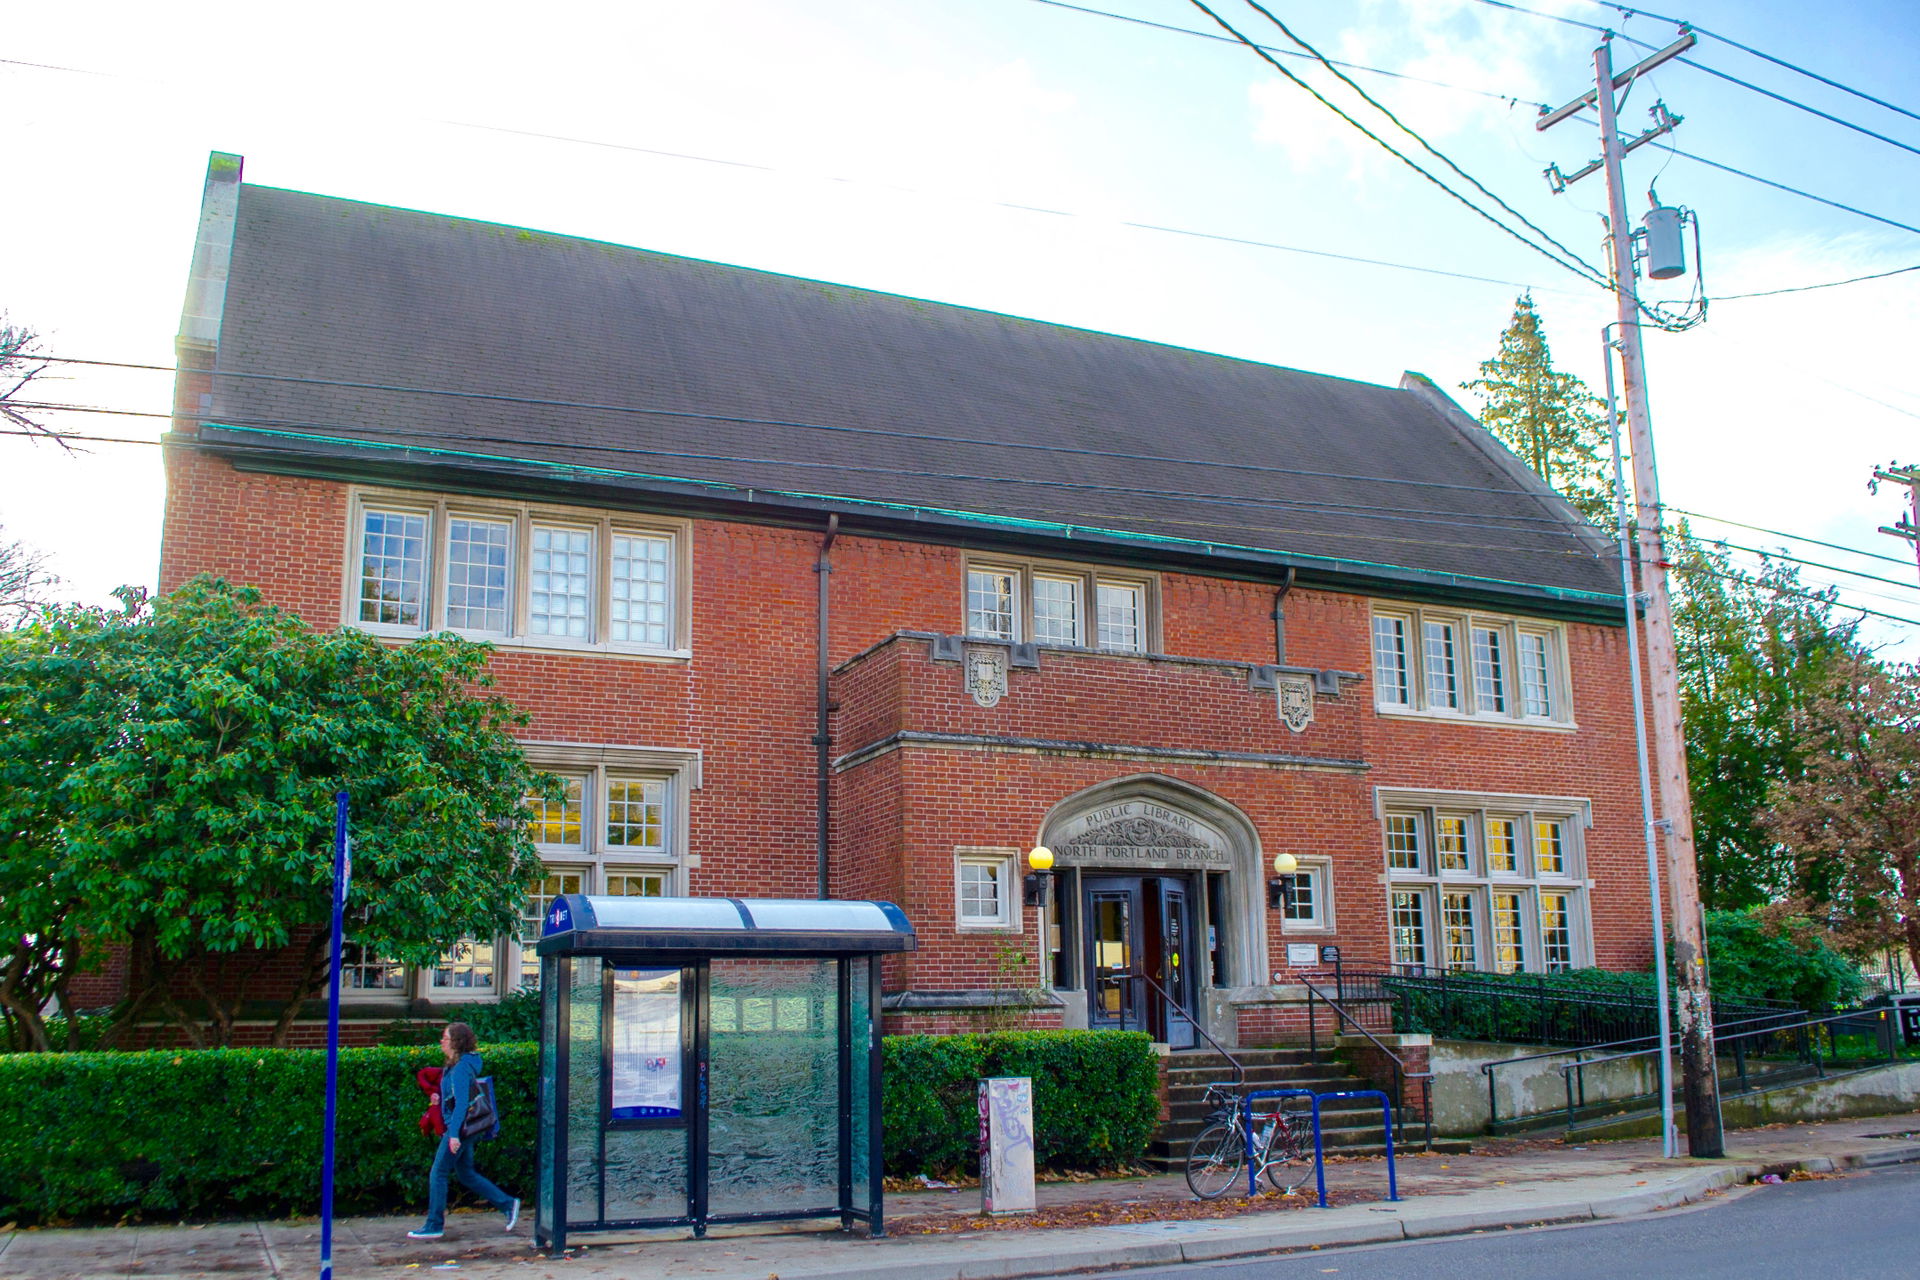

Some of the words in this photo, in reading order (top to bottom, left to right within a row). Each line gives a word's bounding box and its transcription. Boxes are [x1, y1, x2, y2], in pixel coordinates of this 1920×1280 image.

[1086, 804, 1132, 826] PUBLIC
[1143, 804, 1195, 830] LIBRARY
[1054, 845, 1097, 857] NORTH
[1105, 846, 1169, 859] PORTLAND
[1176, 848, 1224, 861] BRANCH
